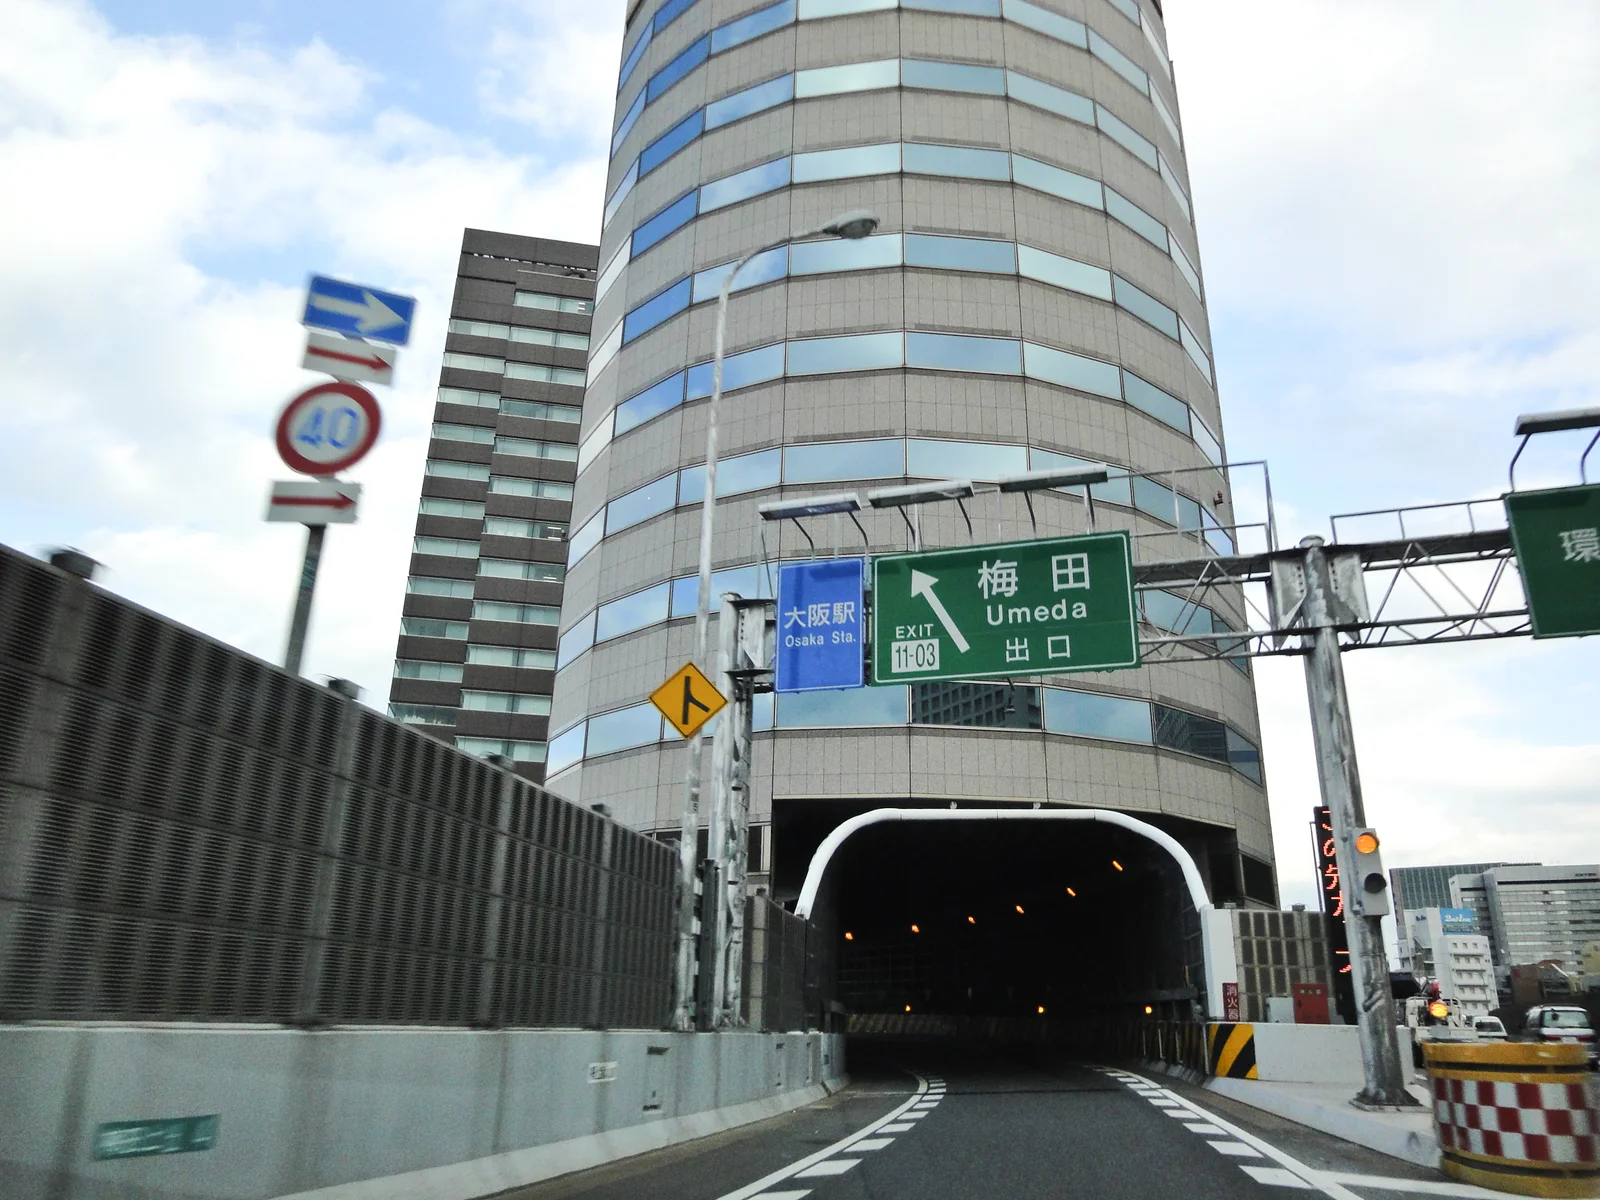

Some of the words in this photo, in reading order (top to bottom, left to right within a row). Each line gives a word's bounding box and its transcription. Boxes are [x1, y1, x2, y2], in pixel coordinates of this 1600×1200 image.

[296, 405, 361, 449] 40
[1558, 527, 1600, 563] 環
[977, 553, 1090, 600] 梅田
[784, 601, 855, 629] 大阪駅
[986, 598, 1087, 626] Umeda
[785, 633, 824, 648] Osaka
[832, 630, 856, 644] Sta.
[896, 623, 934, 639] EXIT
[895, 642, 936, 669] 11-03
[1006, 635, 1071, 663] 出口
[1226, 984, 1239, 1020] 消火器
